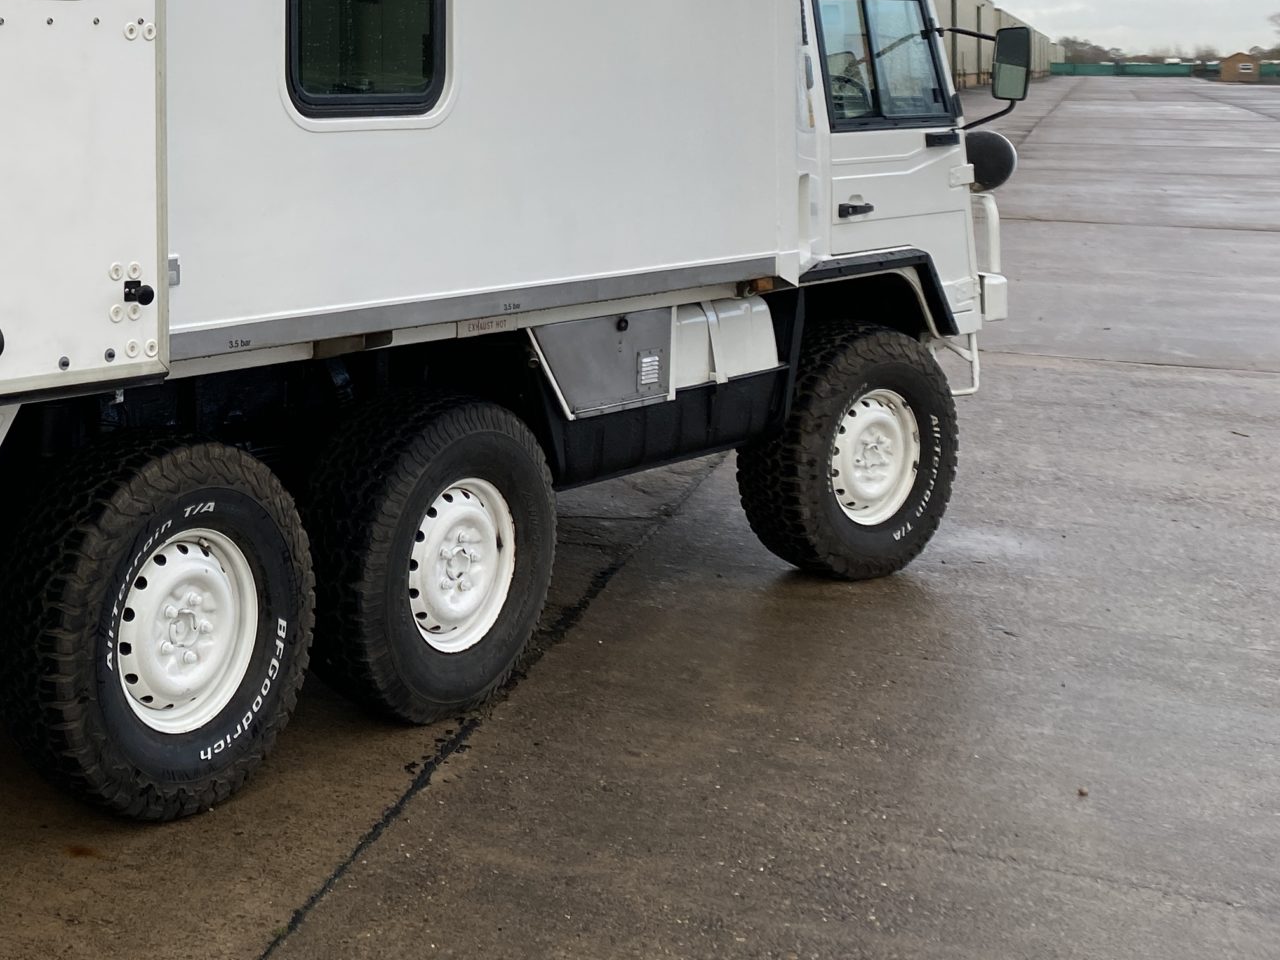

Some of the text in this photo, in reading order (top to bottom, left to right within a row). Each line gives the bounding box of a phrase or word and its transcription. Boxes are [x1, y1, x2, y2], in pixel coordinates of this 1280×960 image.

[468, 319, 507, 332] EXHAUST HOT
[183, 501, 216, 518] T/A
[199, 617, 288, 761] BFGoodrich
